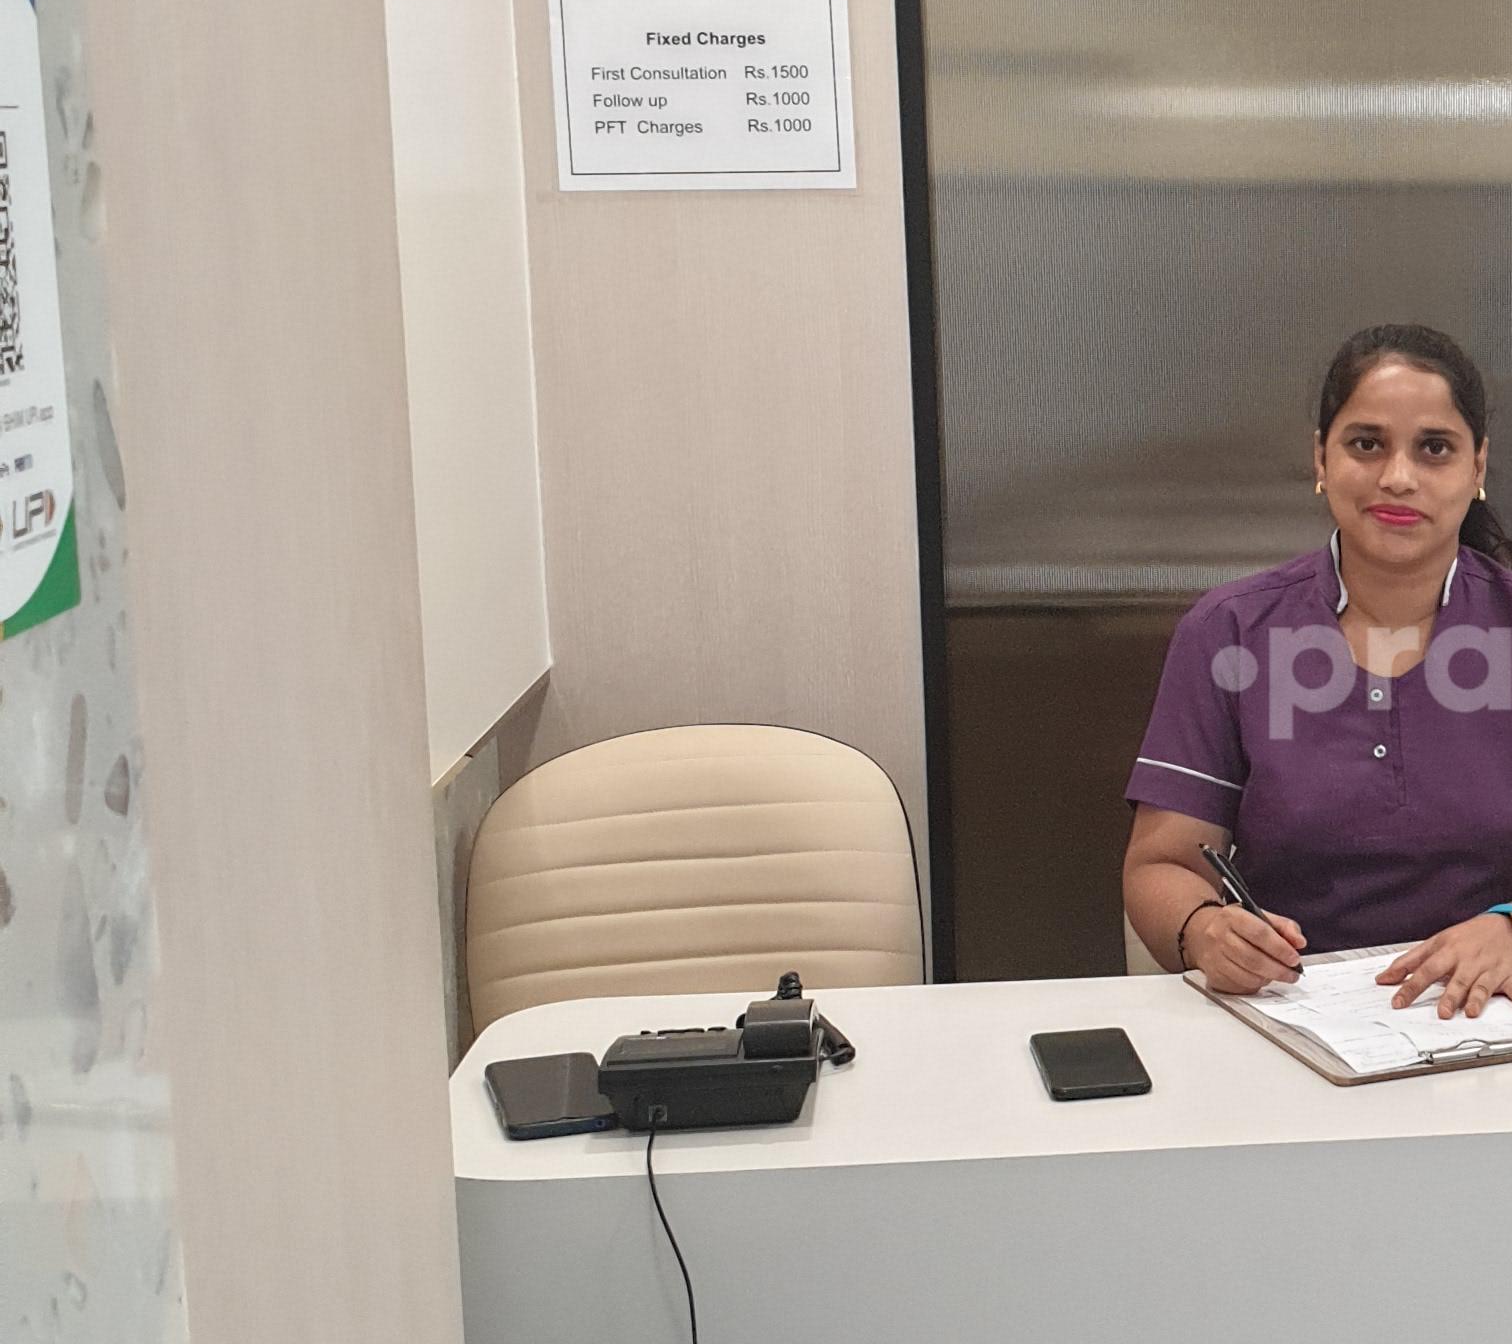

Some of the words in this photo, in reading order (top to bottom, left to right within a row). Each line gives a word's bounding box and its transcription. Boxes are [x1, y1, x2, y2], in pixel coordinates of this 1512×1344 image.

[645, 31, 692, 47] Fixed
[695, 30, 767, 49] Charges
[591, 65, 626, 82] First
[629, 65, 728, 81] Consultation
[743, 64, 810, 80] Rs.1500
[592, 93, 644, 108] Follow
[647, 96, 669, 111] up
[745, 91, 811, 107] Rs.1000
[594, 119, 628, 135] PFT
[636, 119, 705, 138] Charges
[746, 118, 813, 133] Rs.1000
